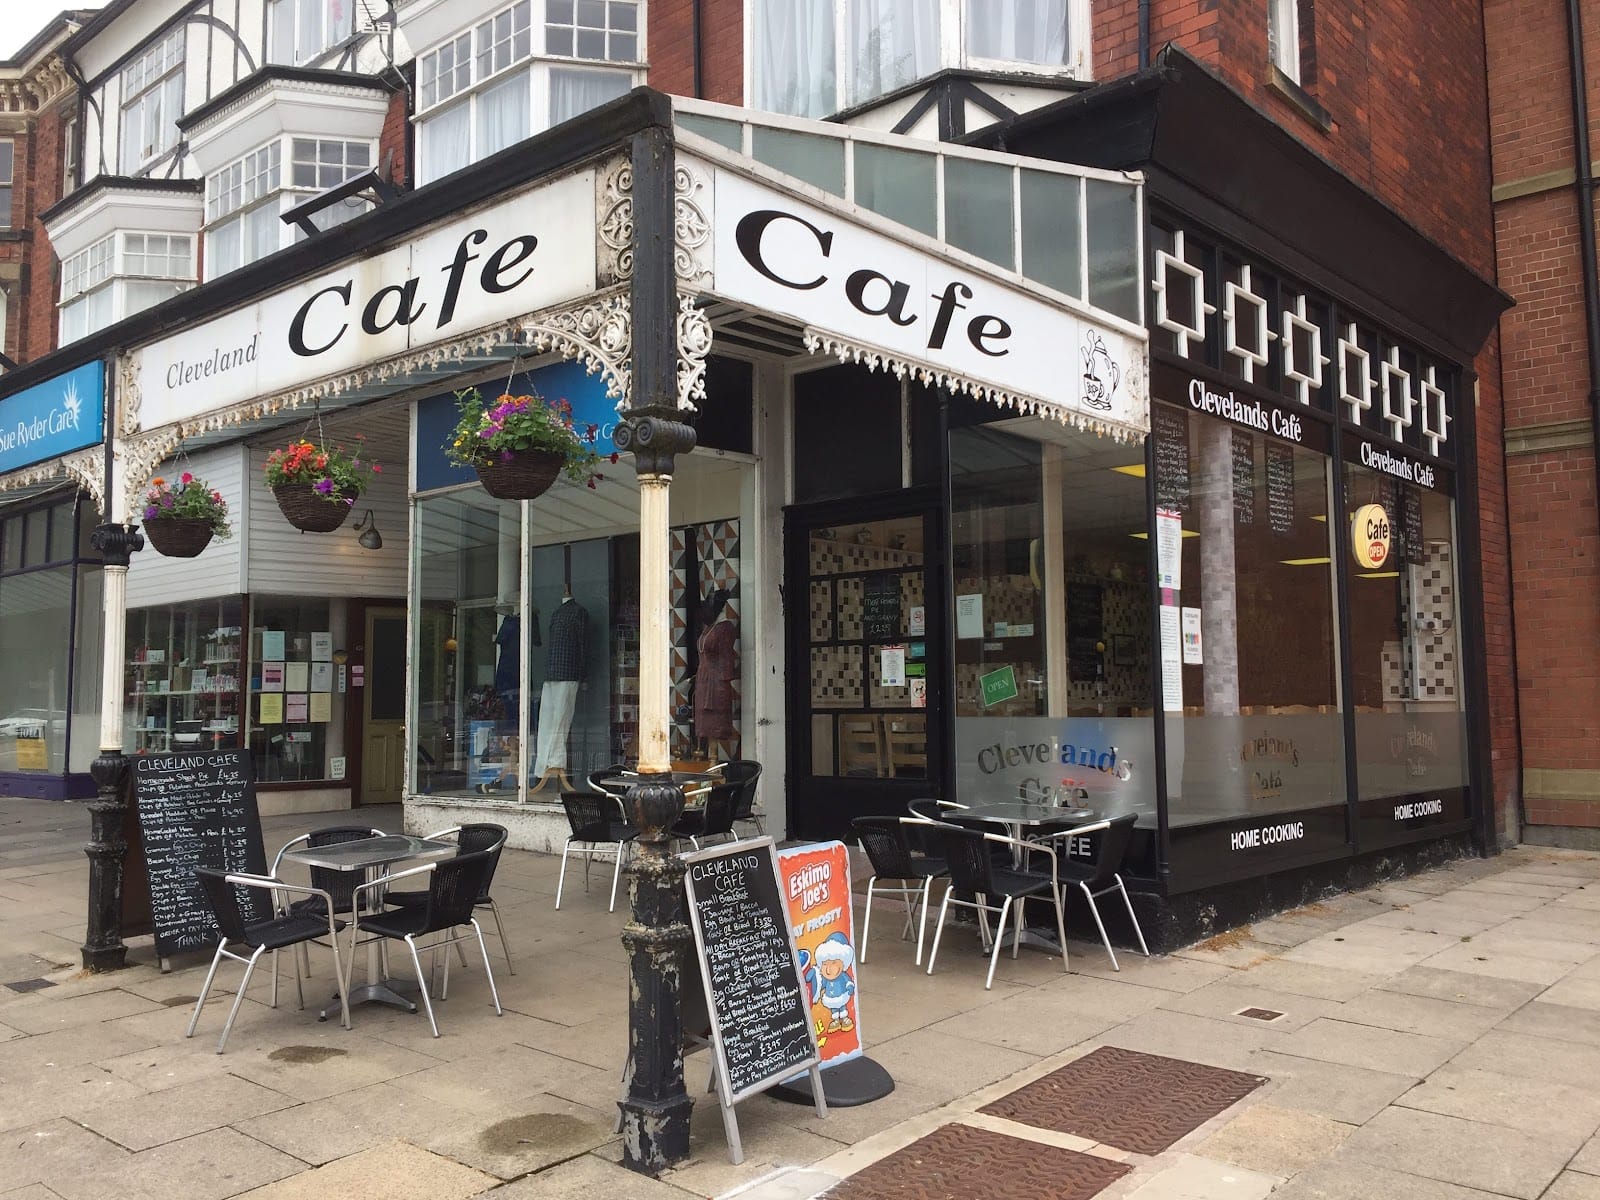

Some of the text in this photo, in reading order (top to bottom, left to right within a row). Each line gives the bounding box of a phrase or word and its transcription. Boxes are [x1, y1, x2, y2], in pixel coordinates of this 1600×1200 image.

[288, 228, 539, 357] Cafe
[735, 209, 1012, 356] Cafe
[166, 334, 258, 390] Cleveland
[1188, 378, 1302, 442] Clevelands Café
[0, 408, 73, 453] Sue Ryder Care
[1361, 441, 1435, 489] Clevelands Café
[1366, 518, 1389, 541] Cafe
[1369, 546, 1385, 558] OPEN
[987, 680, 1010, 694] OPEN
[138, 754, 239, 771] CLEVELAND CAFE
[1394, 799, 1442, 820] HOME COOKING
[1231, 821, 1304, 850] HOME COOKING
[692, 856, 758, 881] CLEVELAND
[714, 871, 745, 891] CAFE
[789, 862, 831, 898] Eskimo
[719, 891, 749, 904] Breakfast
[803, 881, 829, 912] Joe's
[806, 906, 842, 933] FROSTY
[174, 932, 208, 949] THANK
